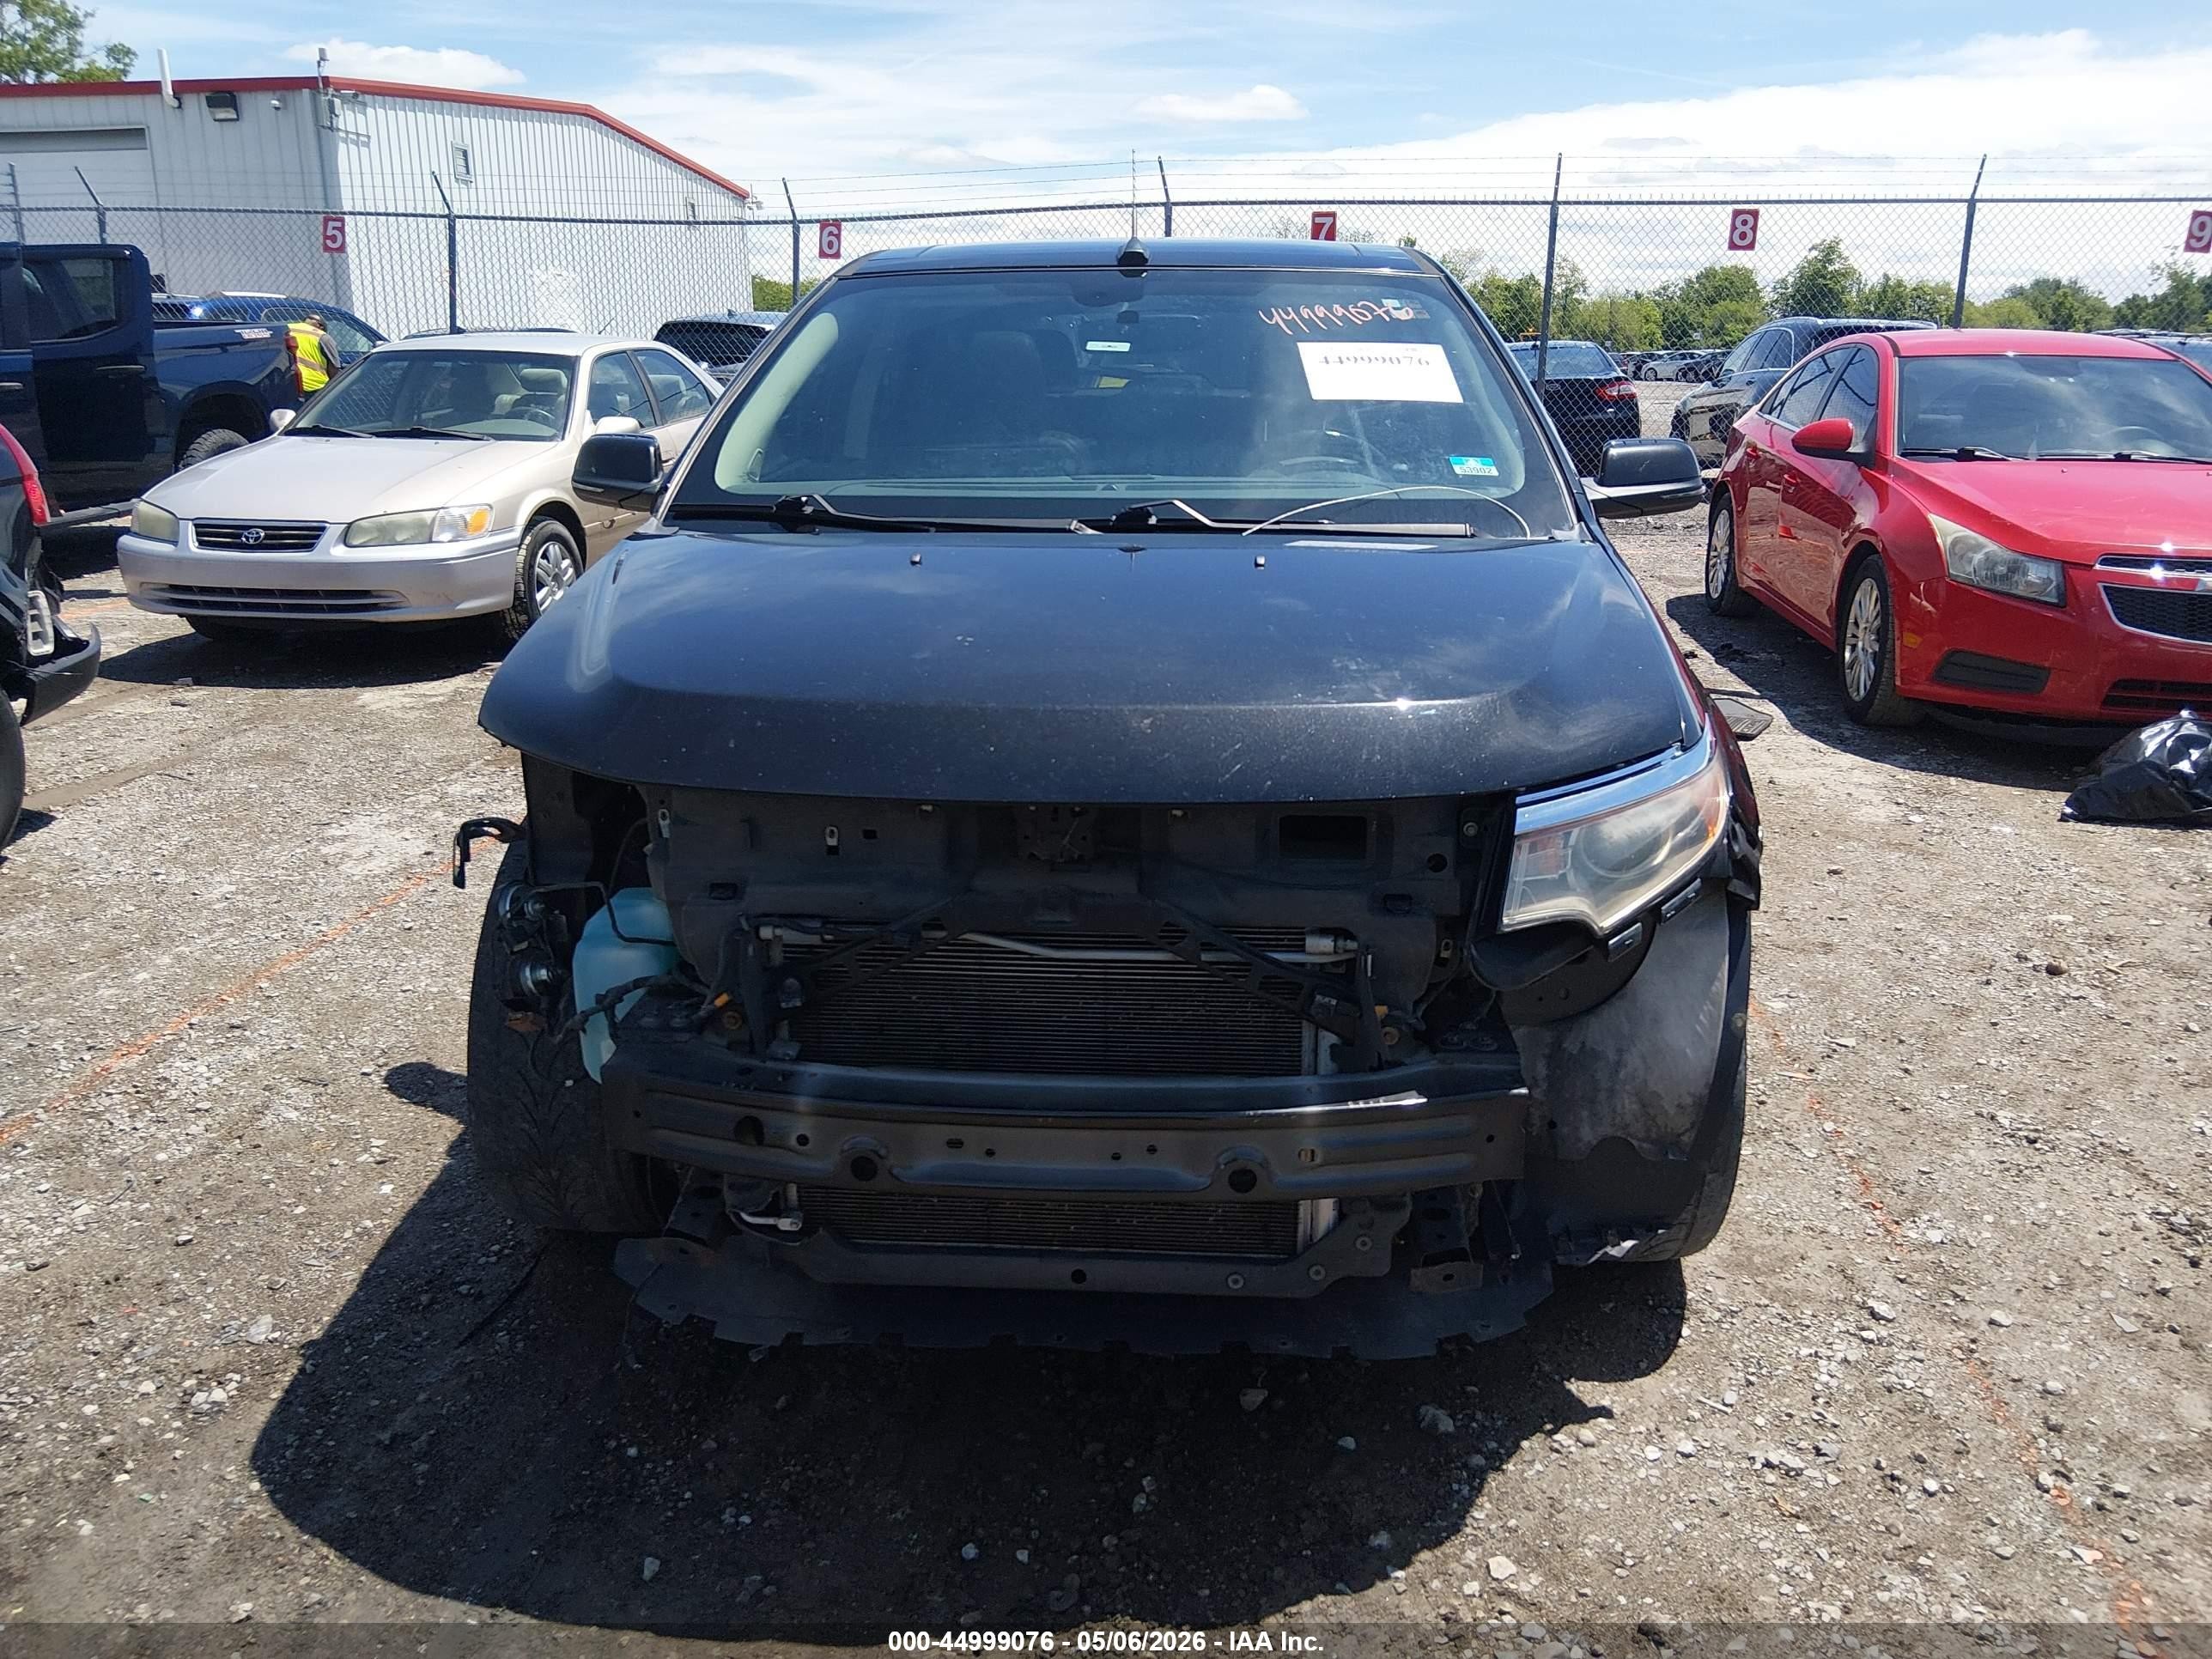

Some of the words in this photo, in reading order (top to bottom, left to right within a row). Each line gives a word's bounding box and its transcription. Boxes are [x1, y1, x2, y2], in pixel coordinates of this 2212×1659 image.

[325, 221, 343, 249] 5
[822, 226, 839, 255] 6
[1315, 216, 1334, 240] 7
[1733, 214, 1754, 246] 8
[2190, 215, 2212, 248] 9
